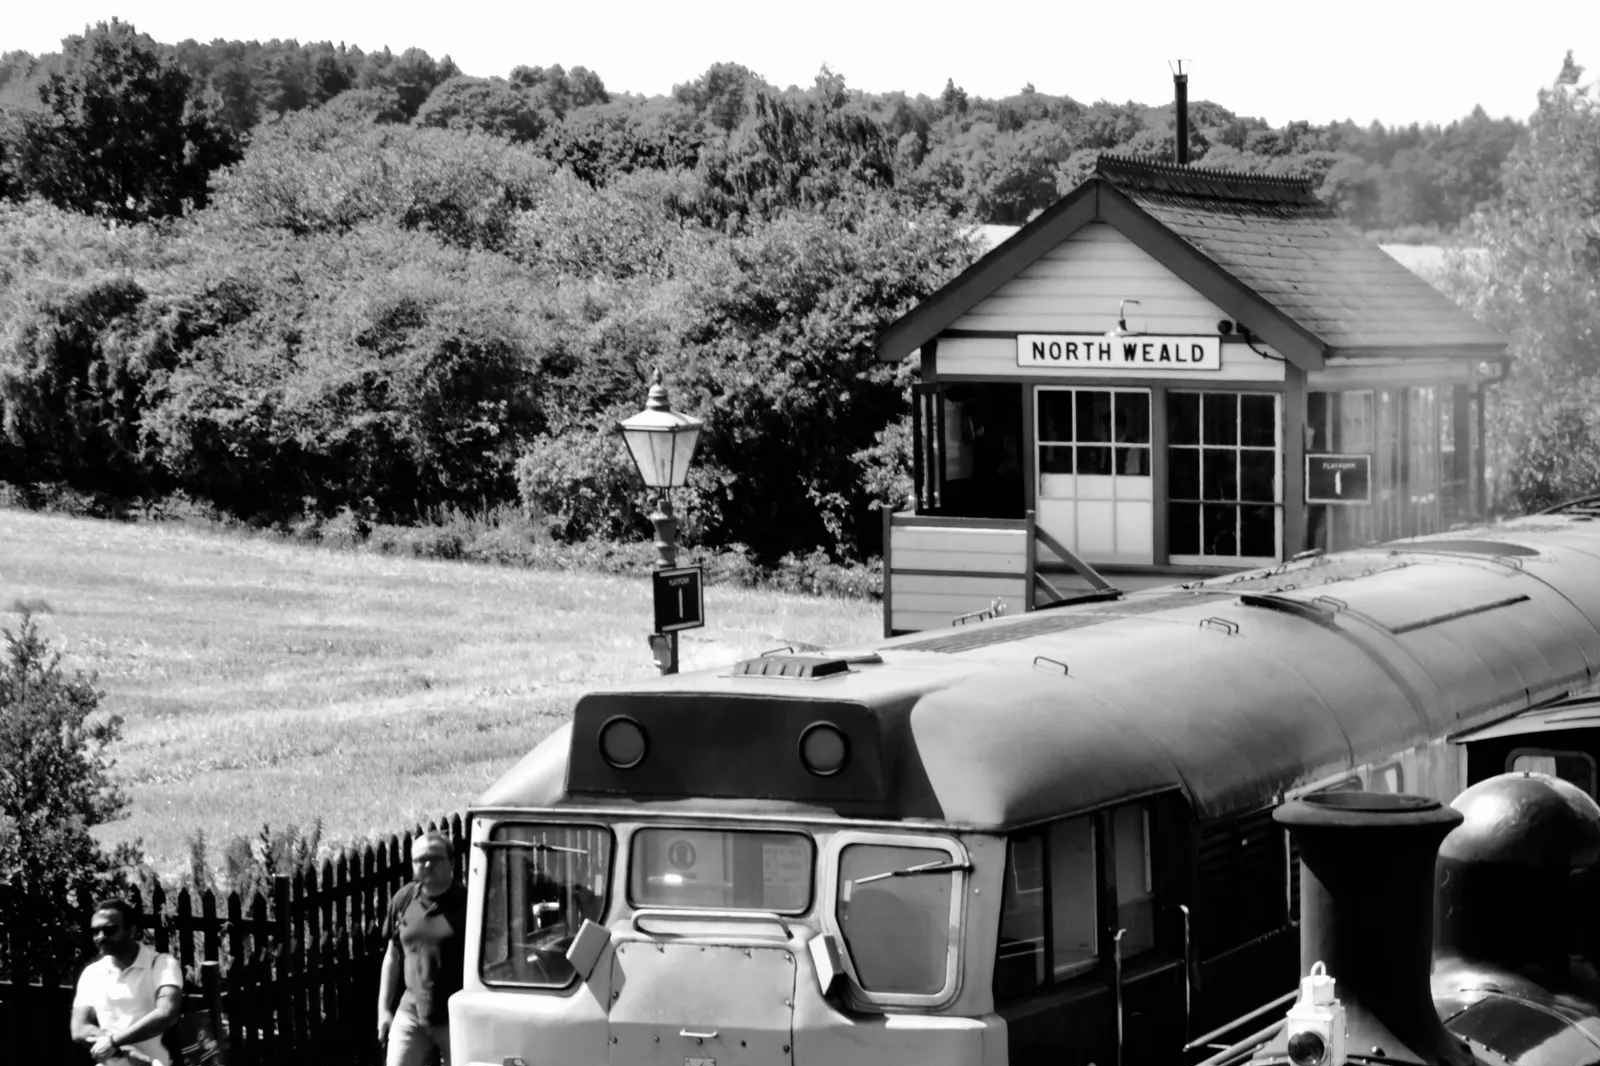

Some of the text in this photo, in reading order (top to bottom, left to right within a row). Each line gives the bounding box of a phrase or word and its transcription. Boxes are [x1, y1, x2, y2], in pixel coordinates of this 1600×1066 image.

[1032, 341, 1205, 363] NORTH WEALD
[1334, 470, 1342, 495] 1
[678, 587, 684, 619] 1
